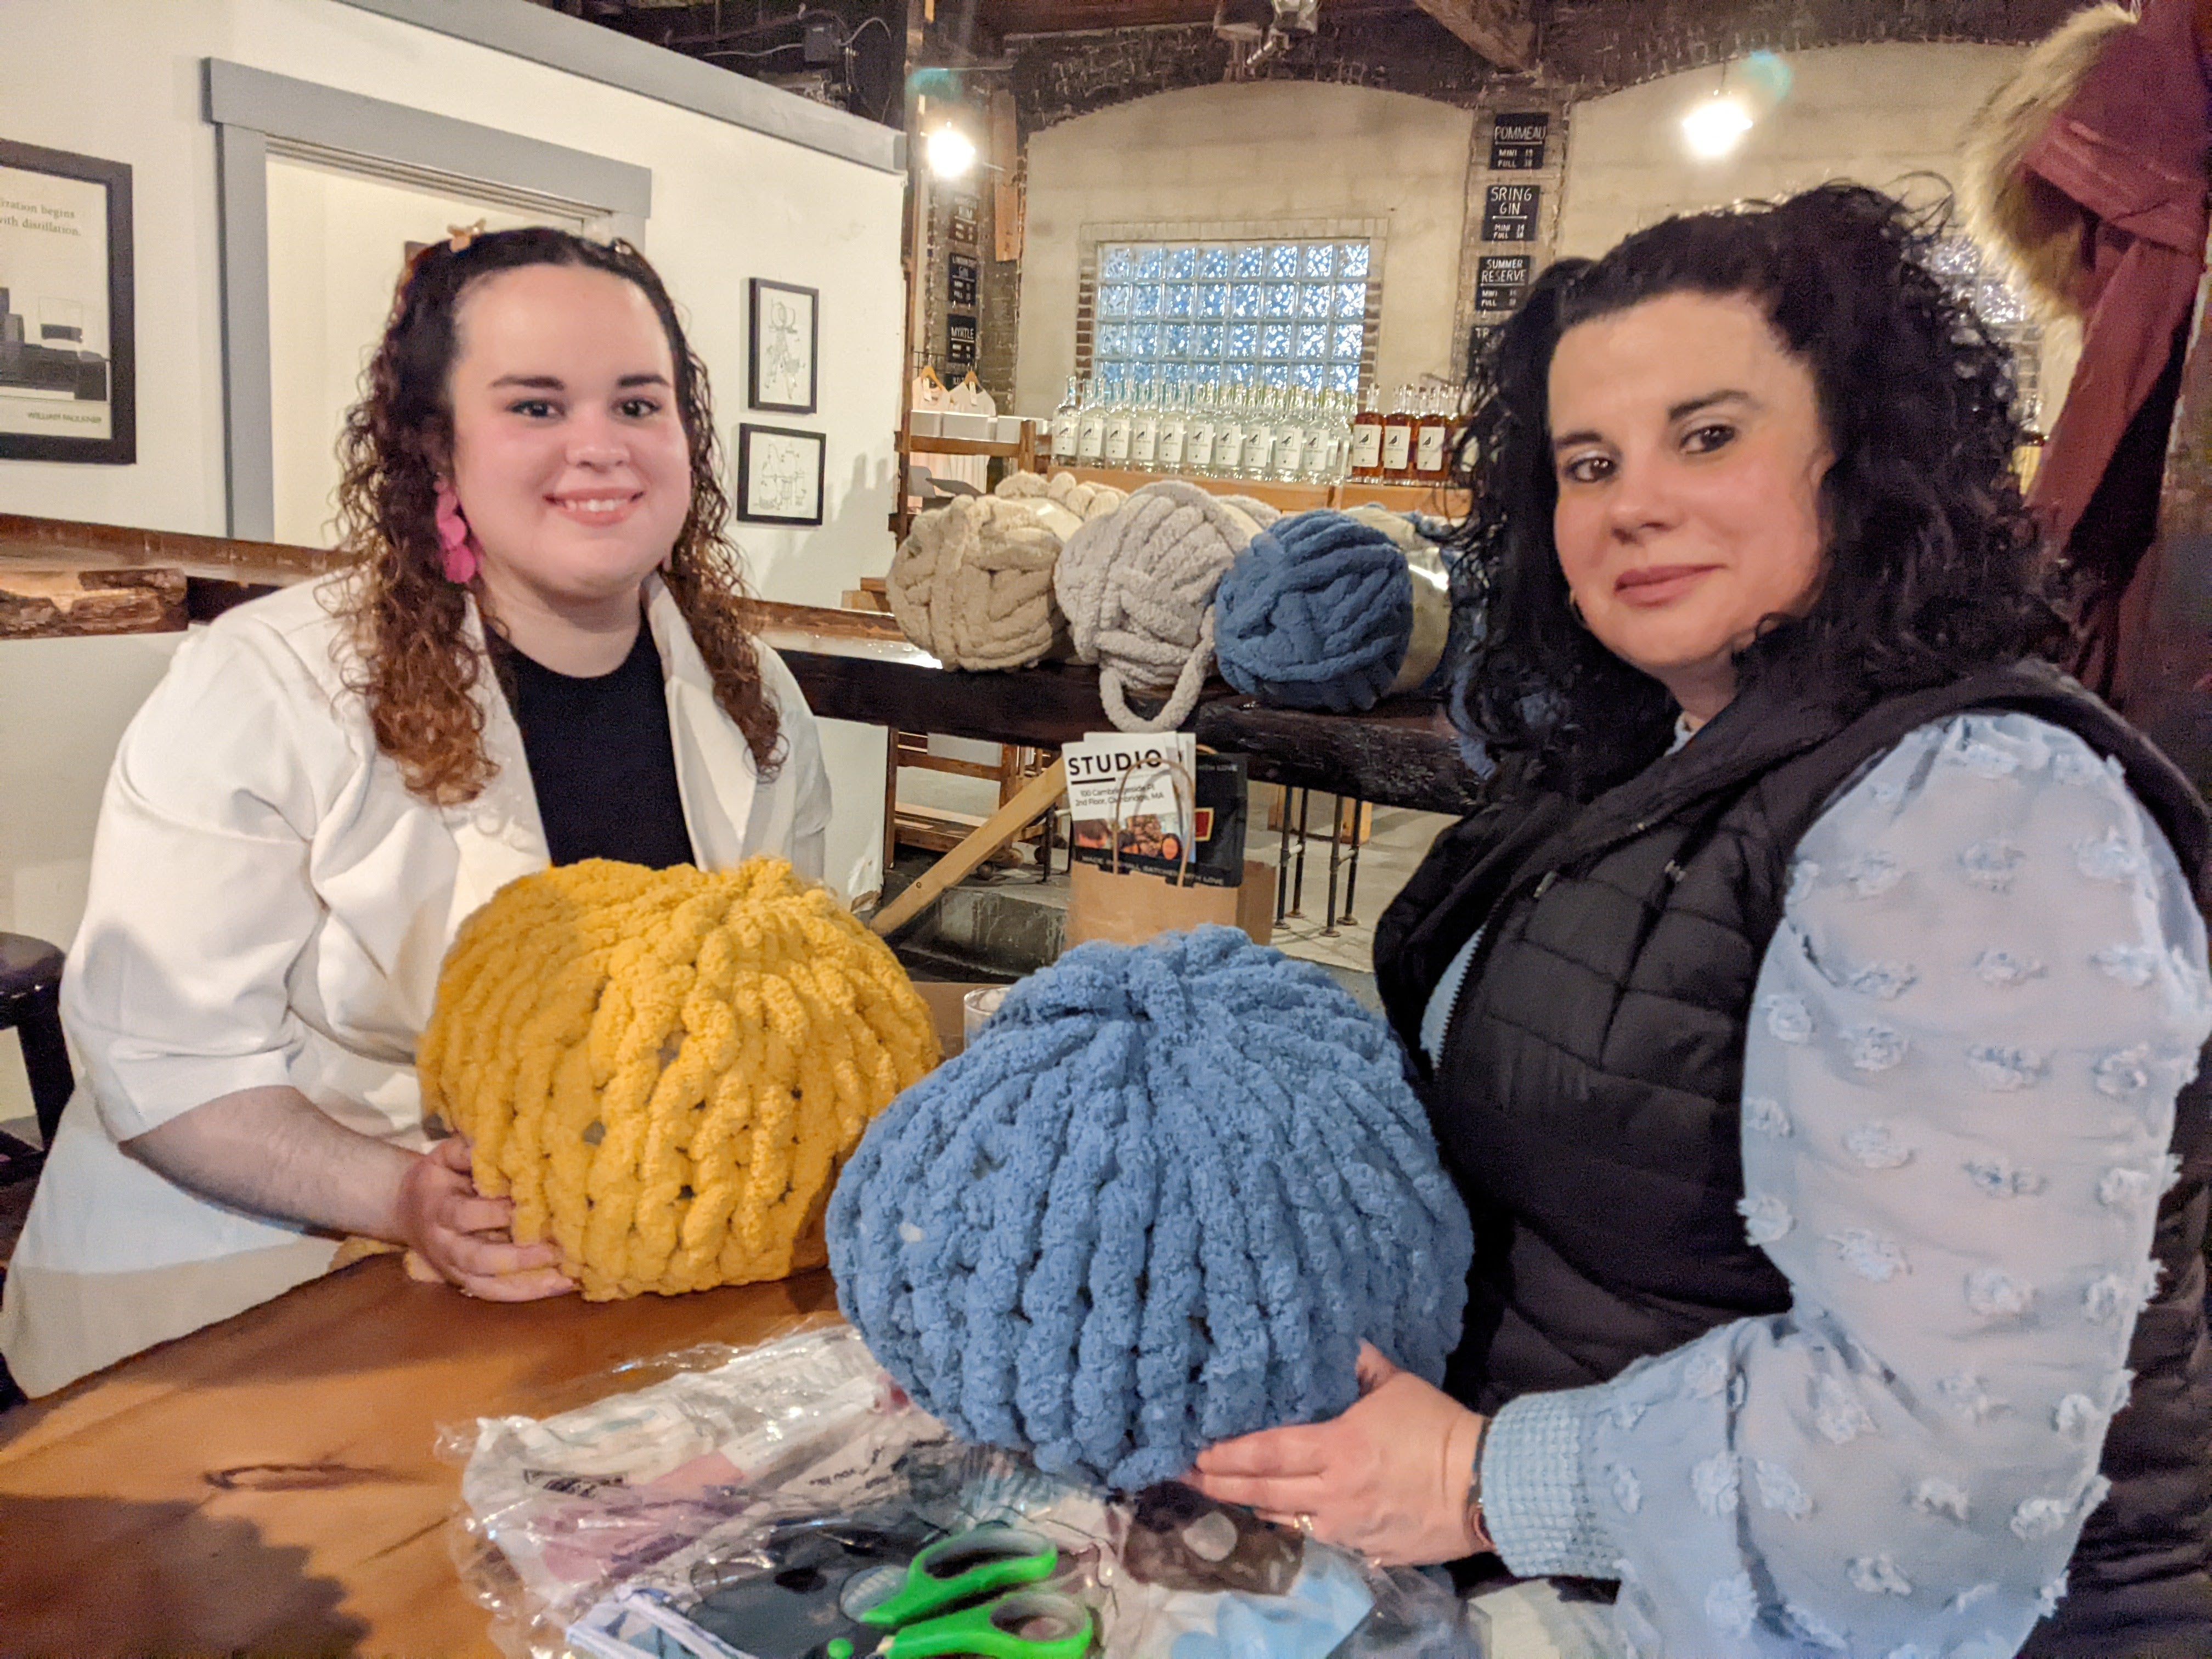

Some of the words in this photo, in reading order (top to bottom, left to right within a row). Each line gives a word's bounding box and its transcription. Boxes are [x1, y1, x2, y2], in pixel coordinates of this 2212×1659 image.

[1494, 126, 1546, 140] POMMEAU
[1498, 159, 1516, 168] FULL
[1491, 187, 1532, 201] SRING
[1499, 202, 1520, 215] GIN
[1487, 259, 1523, 269] SUMMER
[1481, 269, 1526, 283] RESERVE
[1068, 749, 1162, 776] STUDIO
